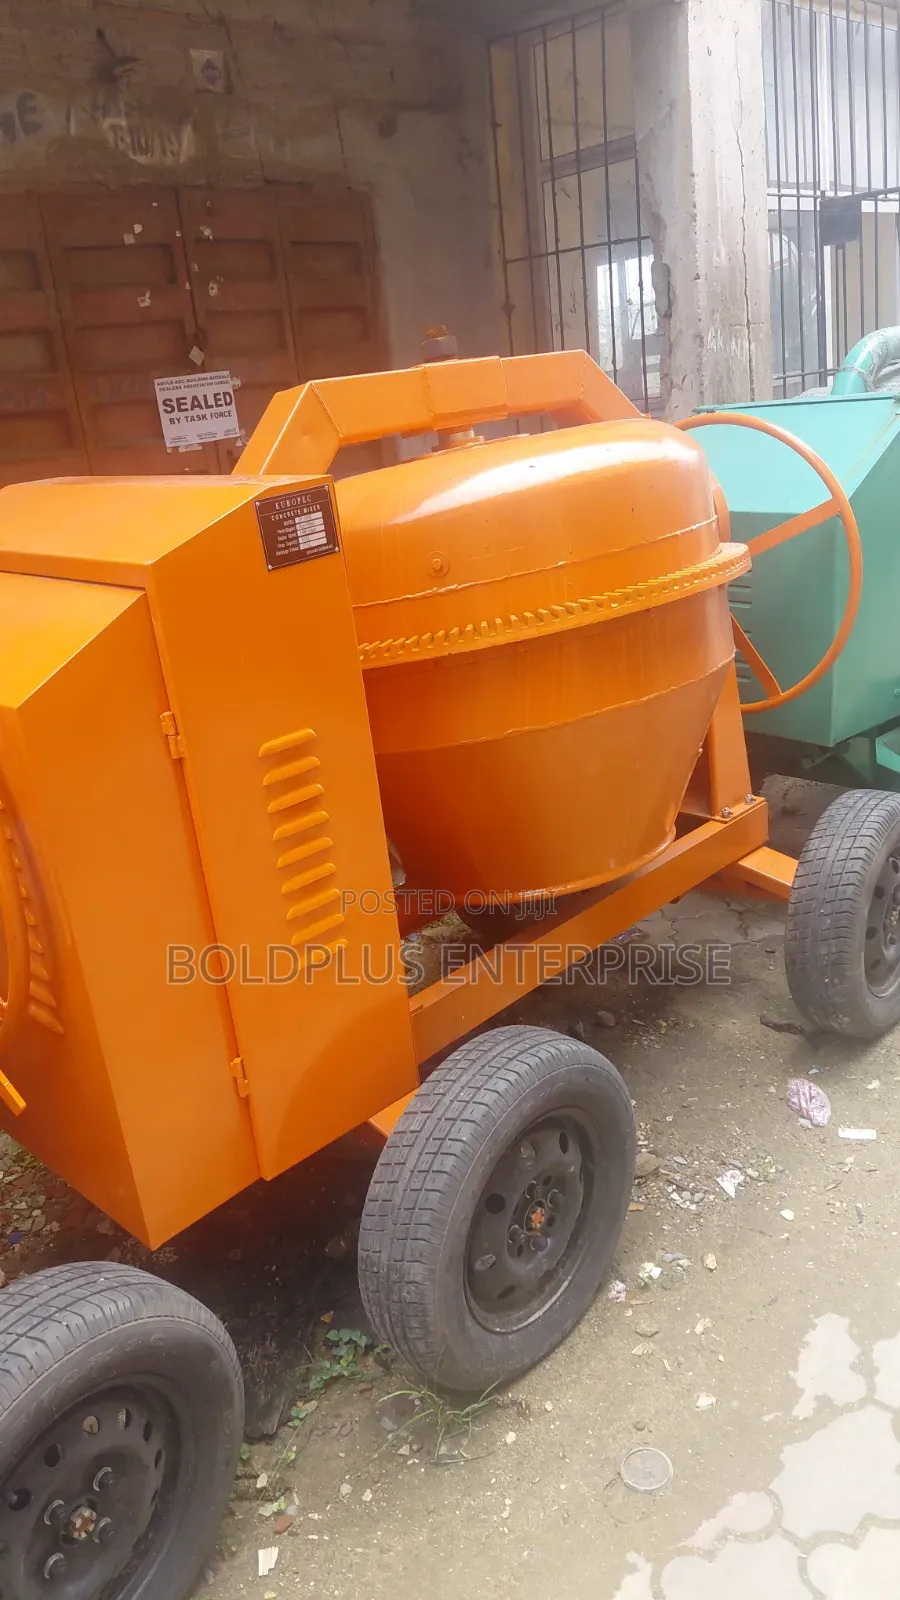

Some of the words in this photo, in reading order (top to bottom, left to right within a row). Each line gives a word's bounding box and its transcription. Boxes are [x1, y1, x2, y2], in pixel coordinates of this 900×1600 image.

[162, 391, 233, 414] SEALED
[169, 417, 181, 425] BY
[184, 414, 208, 423] TASK
[210, 410, 232, 419] FORCE
[275, 495, 312, 509] EUROPEC
[271, 509, 301, 521] CONCRETE
[303, 504, 321, 514] MIXER
